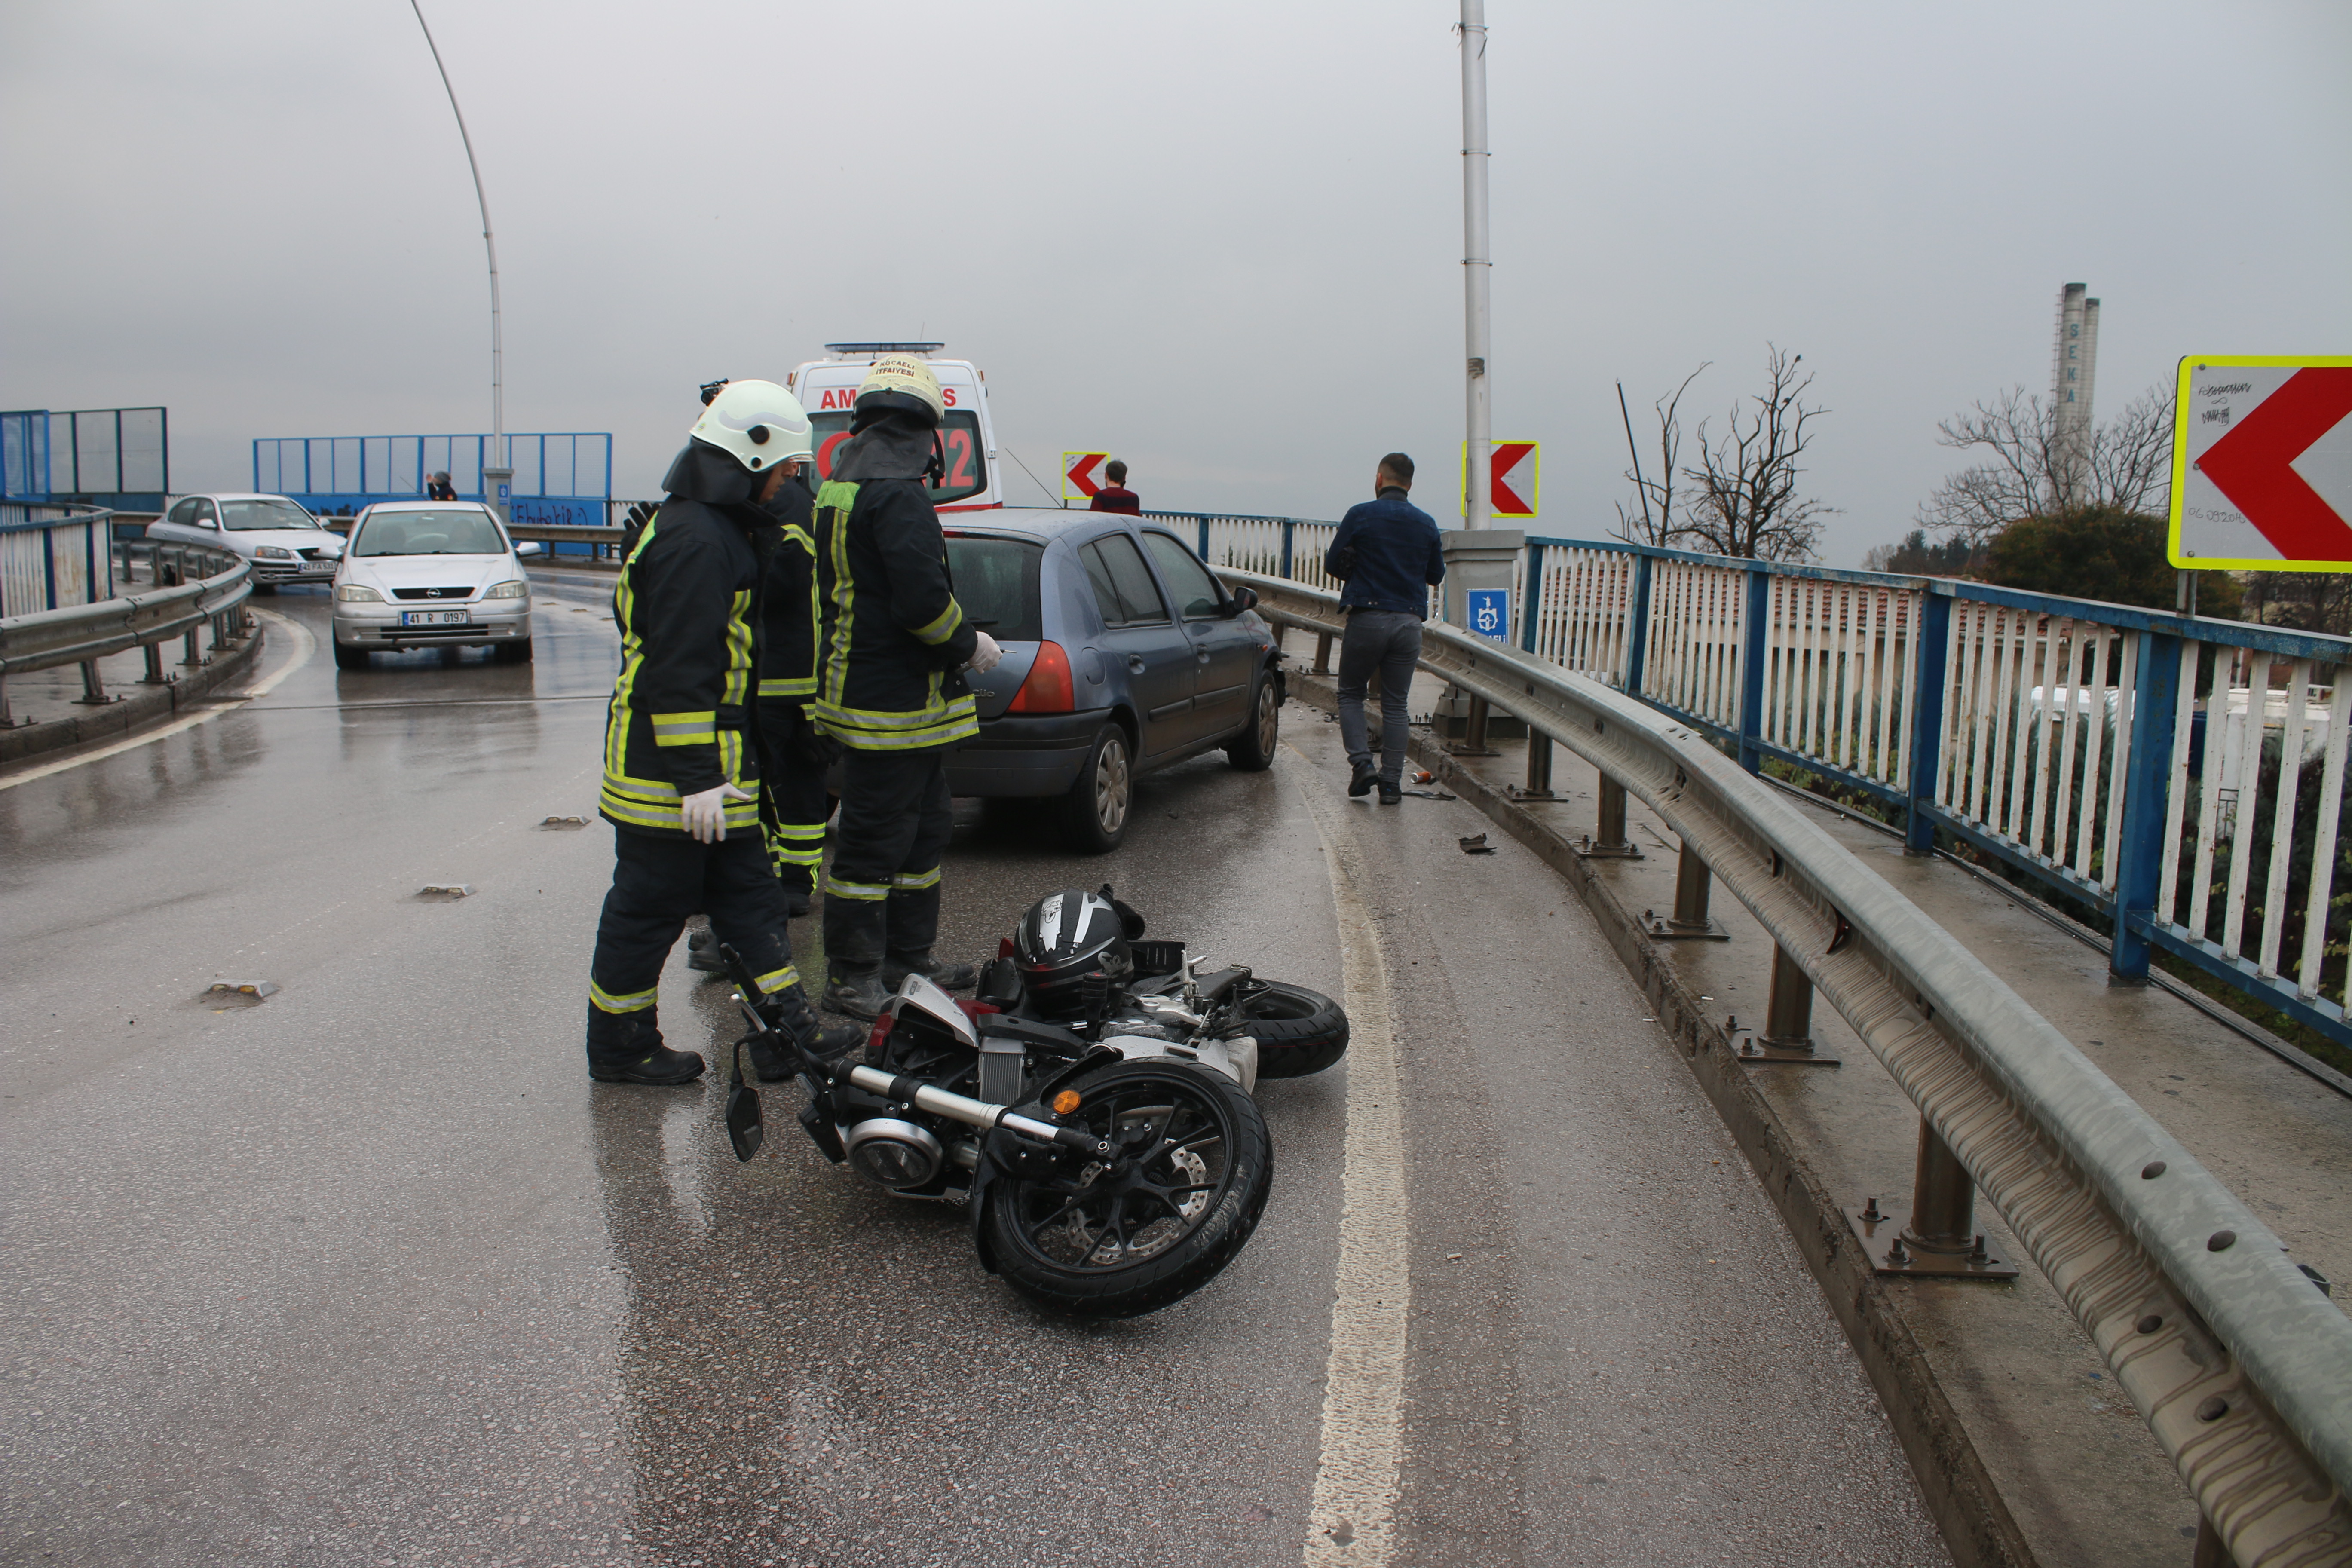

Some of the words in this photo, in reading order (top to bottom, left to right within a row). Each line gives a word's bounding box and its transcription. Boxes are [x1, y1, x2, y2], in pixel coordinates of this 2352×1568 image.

[2067, 323, 2079, 402] SEKA
[410, 614, 420, 623] 41
[428, 613, 434, 623] R
[444, 612, 465, 623] 0197
[973, 688, 995, 697] Clio
